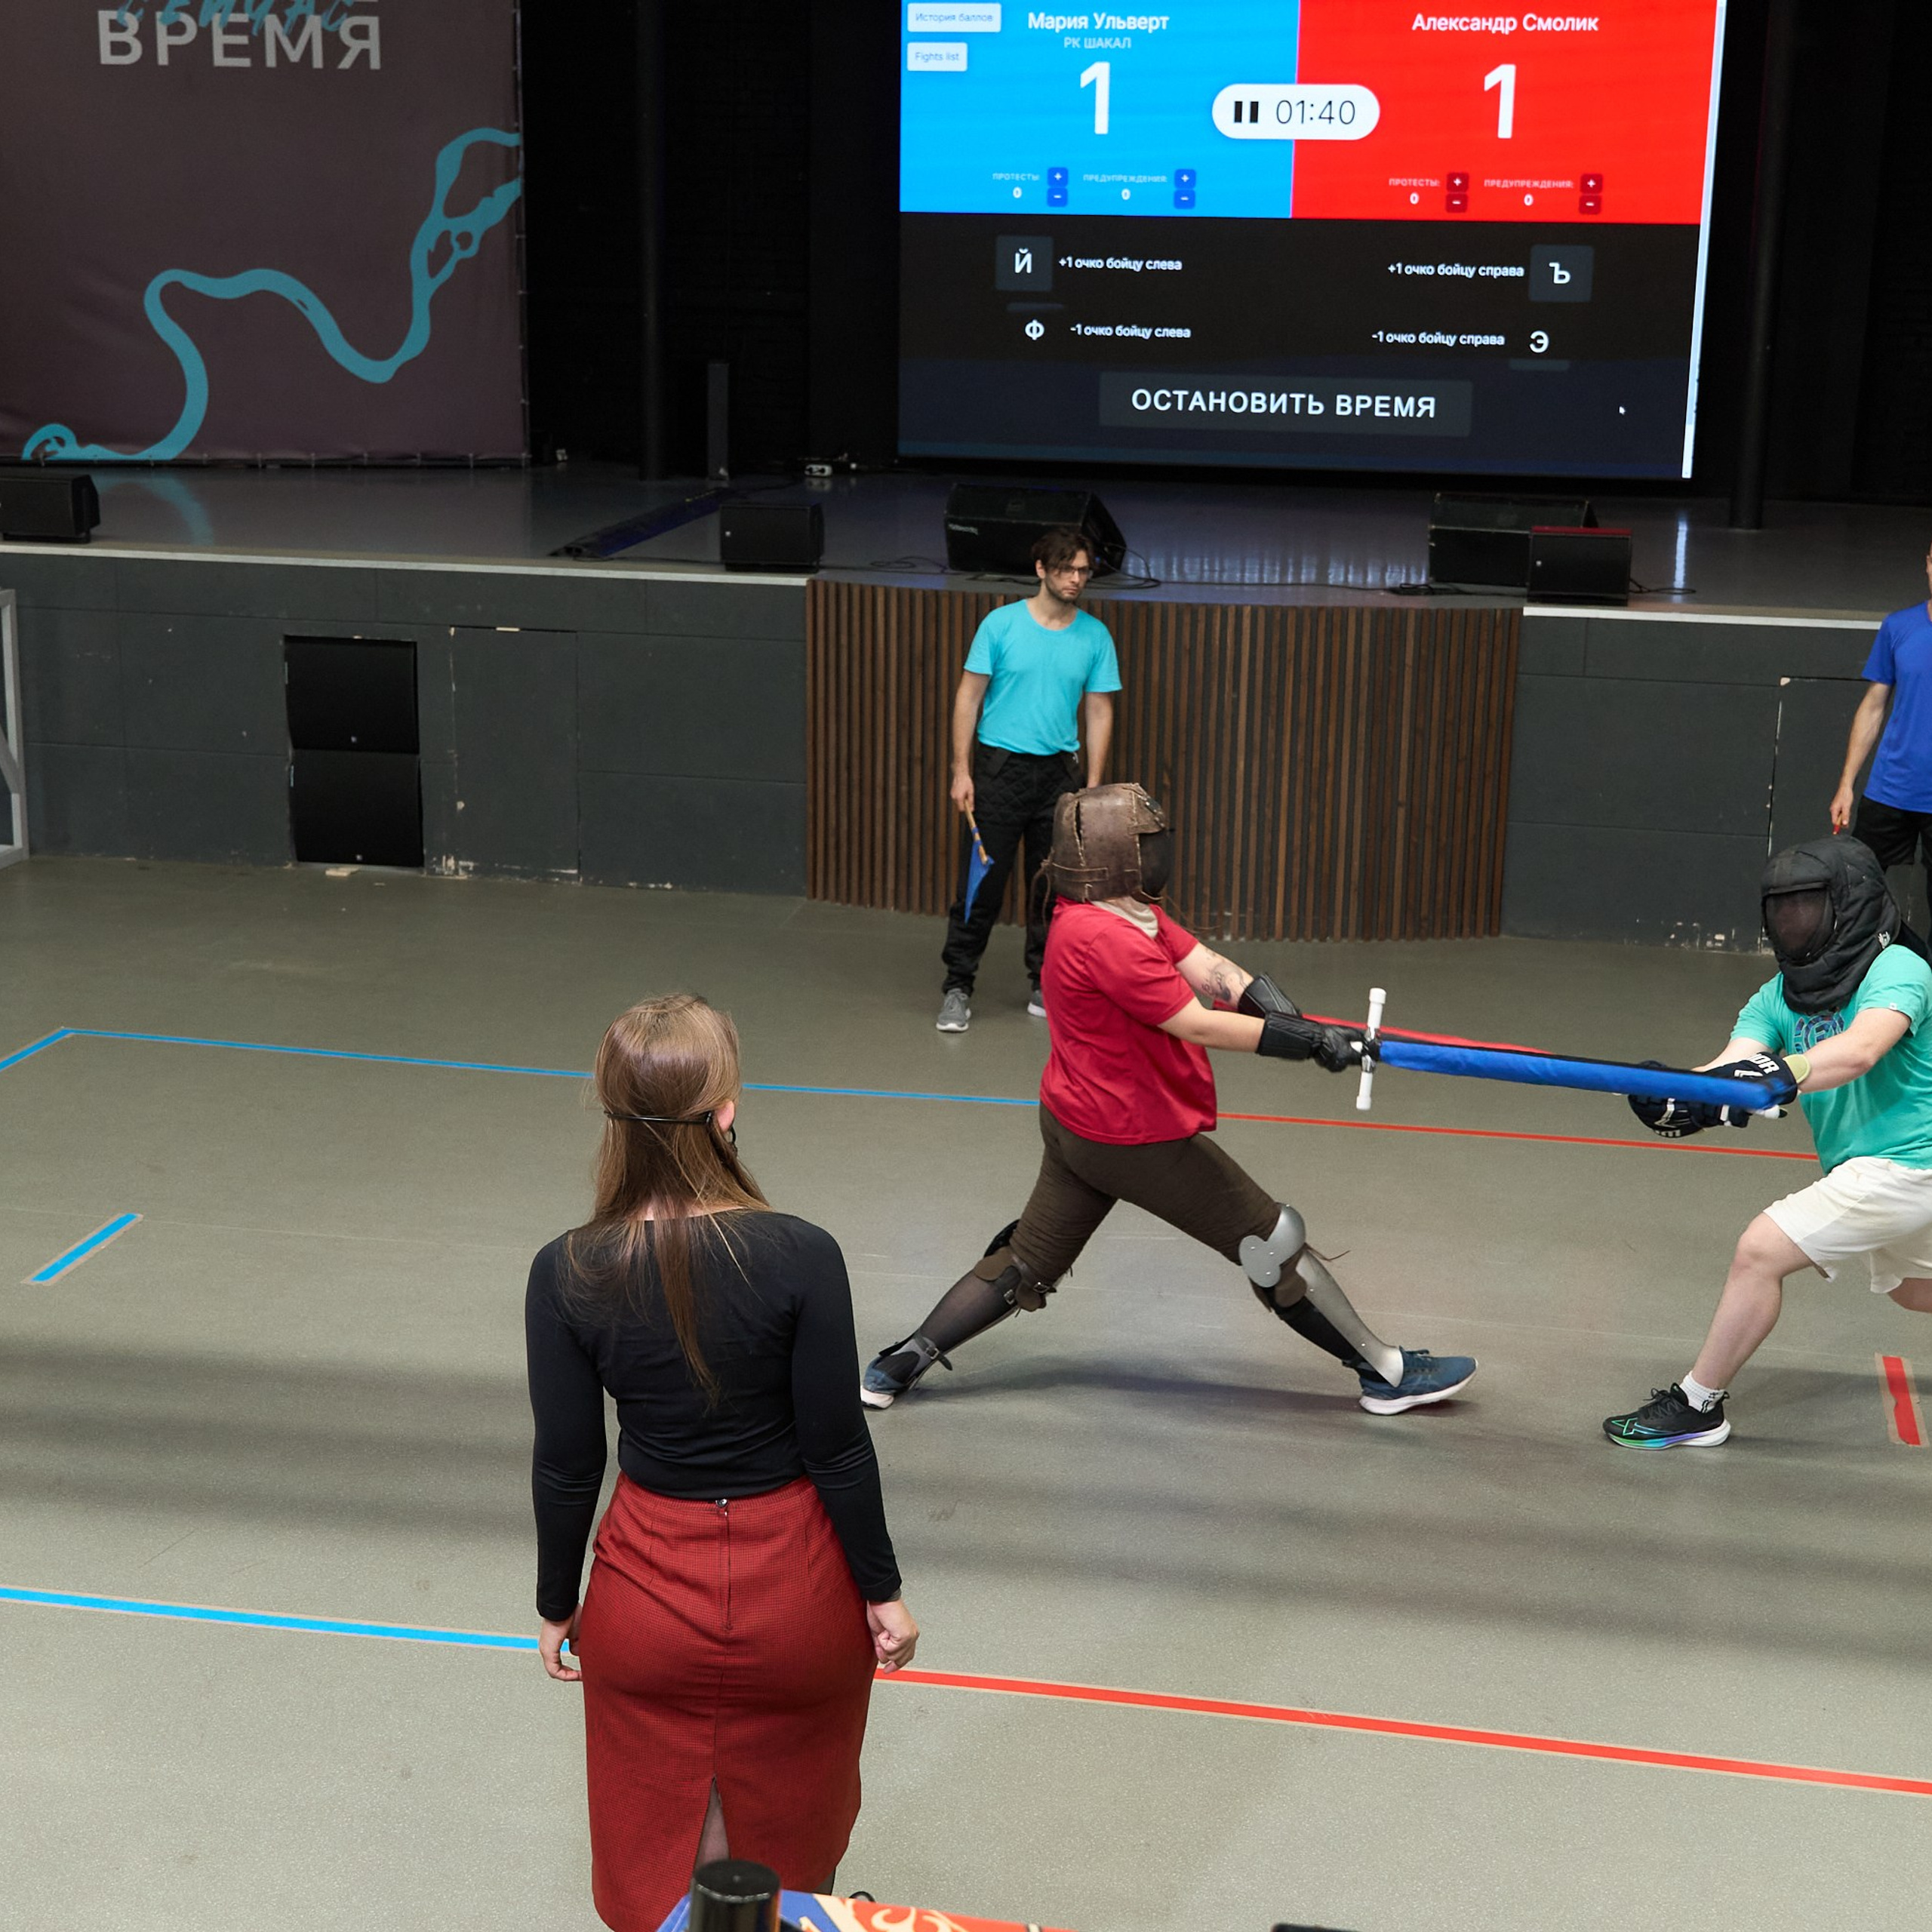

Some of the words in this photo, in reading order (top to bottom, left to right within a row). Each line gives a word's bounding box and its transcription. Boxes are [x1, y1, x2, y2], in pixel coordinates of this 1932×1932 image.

[915, 13, 956, 23] История
[958, 13, 993, 22] баллов
[1028, 12, 1089, 33] Мария
[1093, 12, 1170, 34] Ульверт
[1412, 13, 1517, 35] Александр
[1522, 13, 1599, 32] Смолик
[97, 10, 381, 70] ВРЕМЯ
[1063, 36, 1081, 48] РК
[1084, 37, 1132, 49] ШАКАЛ
[915, 51, 943, 63] Fights
[946, 52, 960, 61] list
[1079, 61, 1111, 135] 1
[1484, 63, 1517, 139] 1
[1275, 100, 1356, 125] 01:40
[1388, 177, 1441, 187] ПРОТЕСТЫ:
[1483, 178, 1574, 189] ПРЕДУПРЕЖДЕНИЯ:
[1012, 186, 1023, 199] 0
[1121, 188, 1131, 201] 0
[1409, 192, 1420, 205] 0
[1523, 193, 1534, 206] 0
[1014, 248, 1033, 274] Й
[1059, 256, 1072, 268] +1
[1074, 258, 1105, 269] очко
[1106, 257, 1144, 272] бойцу
[1146, 259, 1183, 271] слева
[1388, 262, 1403, 274] +1
[1404, 264, 1435, 275] очко
[1437, 263, 1476, 278] бойцу
[1478, 265, 1525, 279] справа
[1549, 261, 1572, 285] Ъ
[1024, 318, 1045, 341] Ф
[1069, 324, 1083, 336] -1
[1084, 326, 1114, 337] очко
[1115, 325, 1152, 340] бойцу
[1154, 328, 1192, 339] слева
[1371, 331, 1384, 343] -1
[1386, 332, 1417, 344] очко
[1418, 331, 1457, 347] бойцу
[1459, 334, 1506, 347] справа
[1529, 330, 1549, 353] Э
[1131, 388, 1325, 416] ОСТАНОВИТЬ
[1335, 394, 1436, 419] ВРЕМЯ
